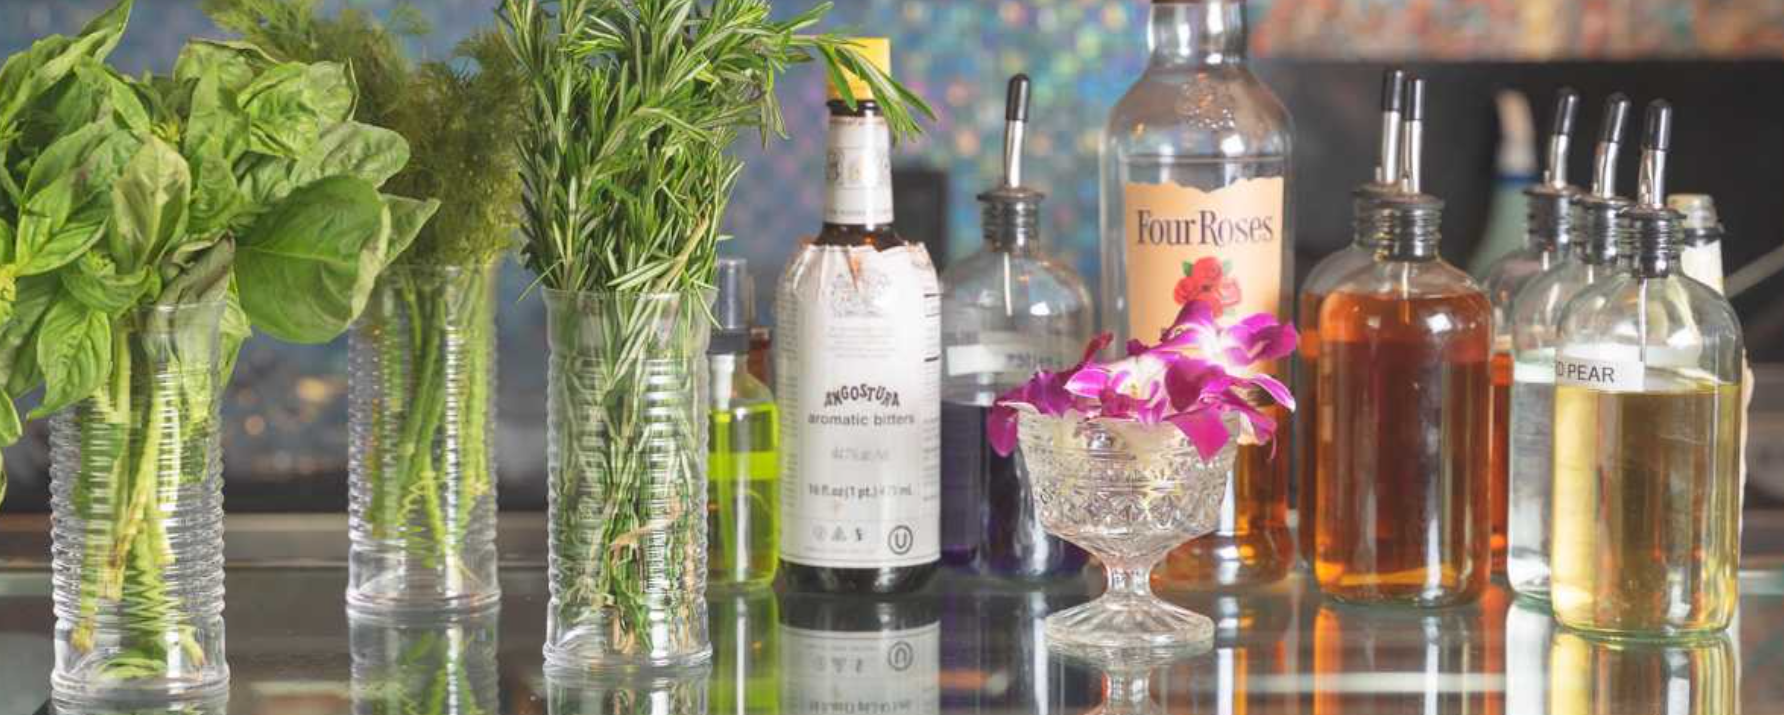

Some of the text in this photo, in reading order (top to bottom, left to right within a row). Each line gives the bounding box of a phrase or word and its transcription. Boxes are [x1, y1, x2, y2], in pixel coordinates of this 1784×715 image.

[1137, 210, 1274, 246] Four Roses
[1567, 363, 1615, 384] PEAR
[824, 383, 899, 407] ANGOSTURA
[808, 413, 915, 426] aromatic bitters
